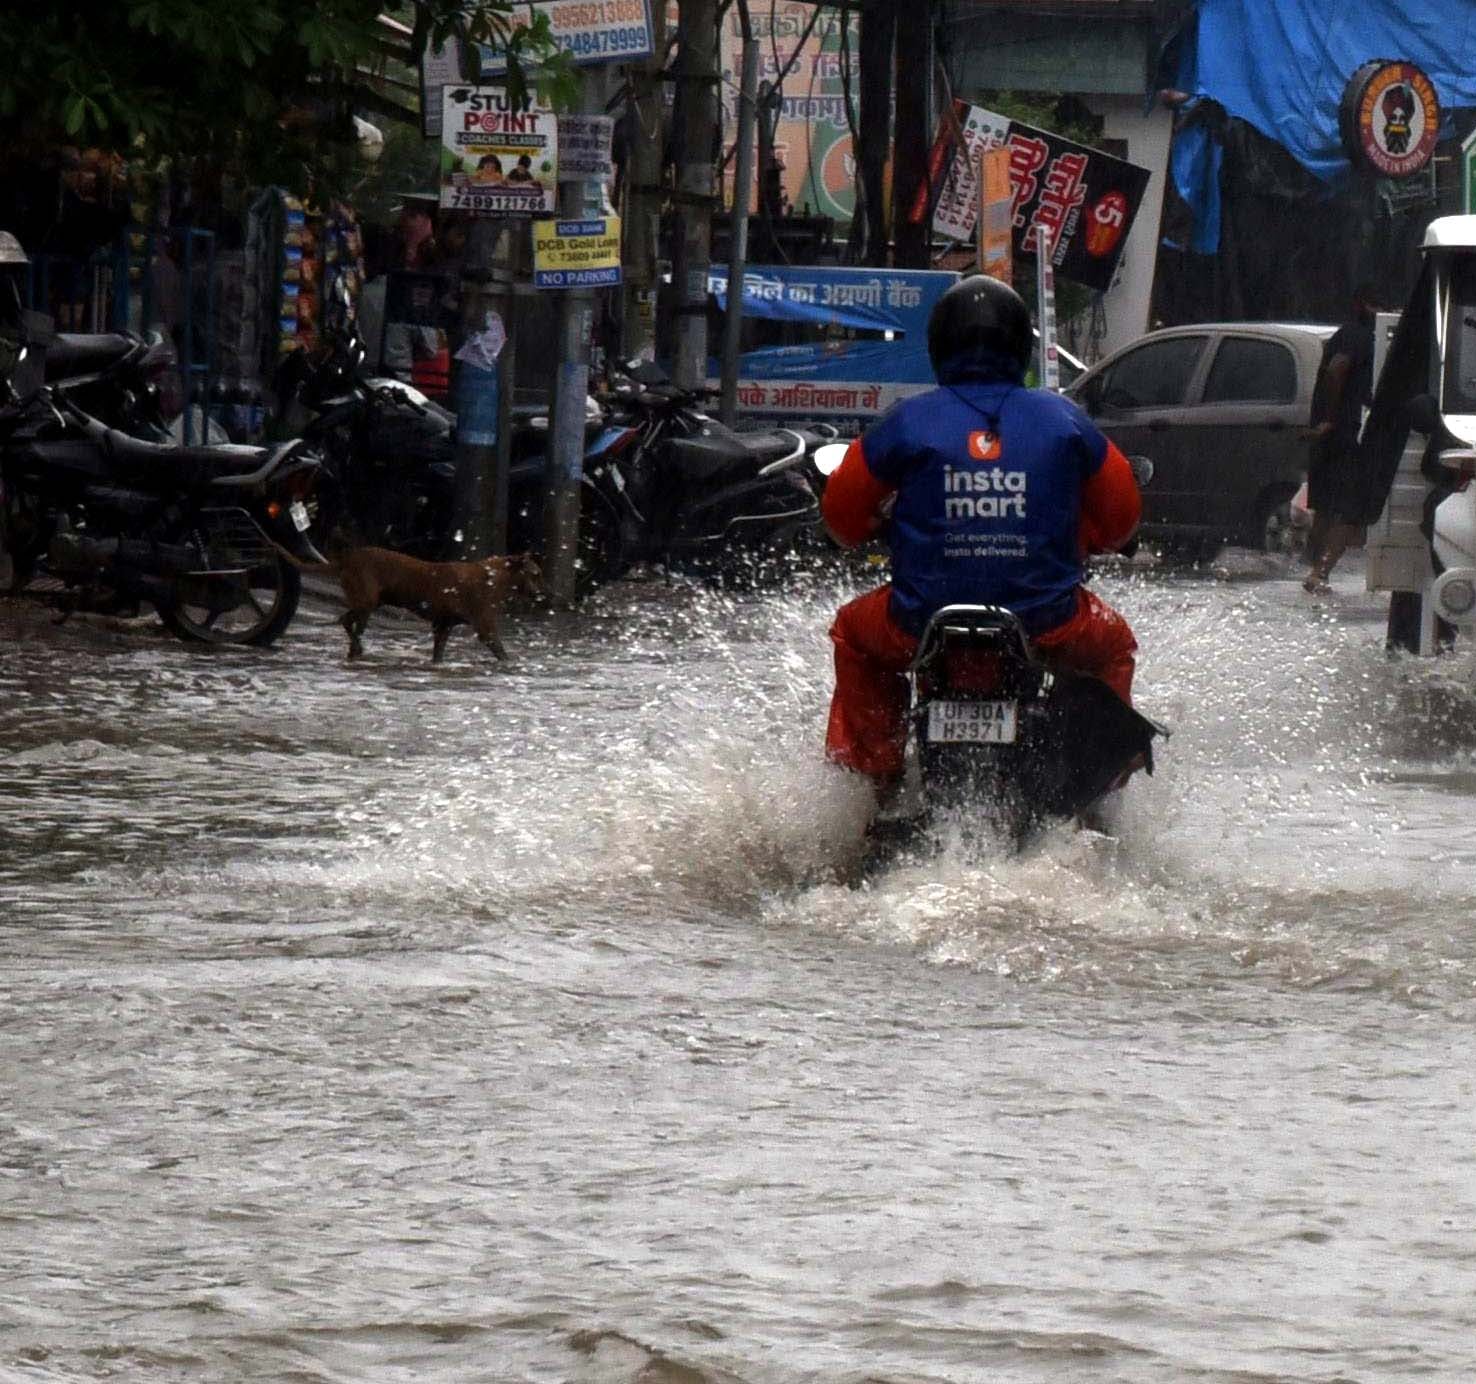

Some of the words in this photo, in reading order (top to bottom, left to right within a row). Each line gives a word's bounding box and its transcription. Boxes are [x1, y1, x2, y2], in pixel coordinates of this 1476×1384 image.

[537, 239, 565, 251] DCB
[542, 272, 563, 285] NO
[567, 269, 617, 283] PARKING
[789, 283, 816, 303] का
[887, 279, 921, 308] बैंक
[773, 383, 858, 409] आशियाना
[862, 385, 883, 411] में
[943, 464, 1027, 492] insta
[944, 493, 1027, 519] mart
[945, 532, 965, 543] Get
